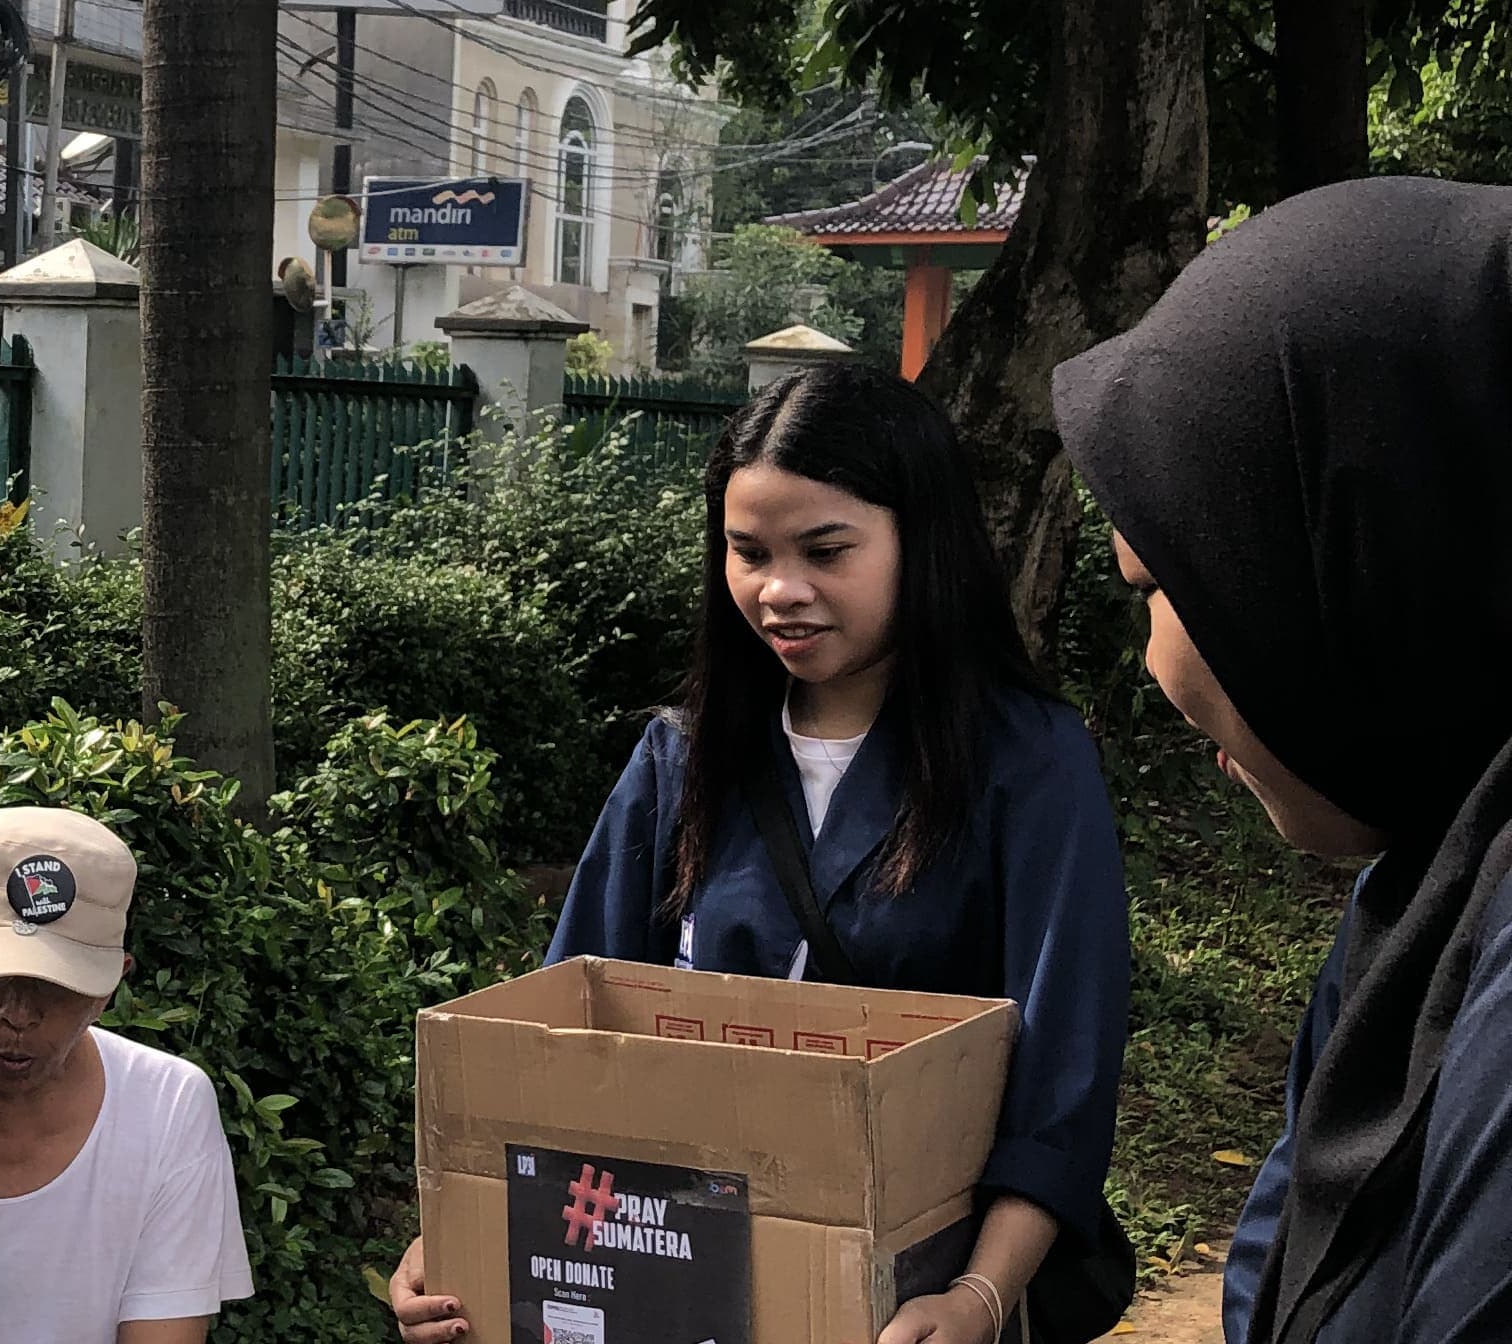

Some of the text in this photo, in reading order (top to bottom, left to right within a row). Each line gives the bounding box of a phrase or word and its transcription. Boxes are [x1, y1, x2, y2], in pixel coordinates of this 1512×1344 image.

[390, 203, 471, 224] mandiri
[388, 227, 419, 241] atm
[22, 861, 61, 875] STAND
[22, 902, 67, 917] PALESTINE
[614, 1193, 668, 1227] PRAY
[592, 1220, 693, 1261] SUMATERA
[531, 1255, 615, 1290] OPEN DONATE
